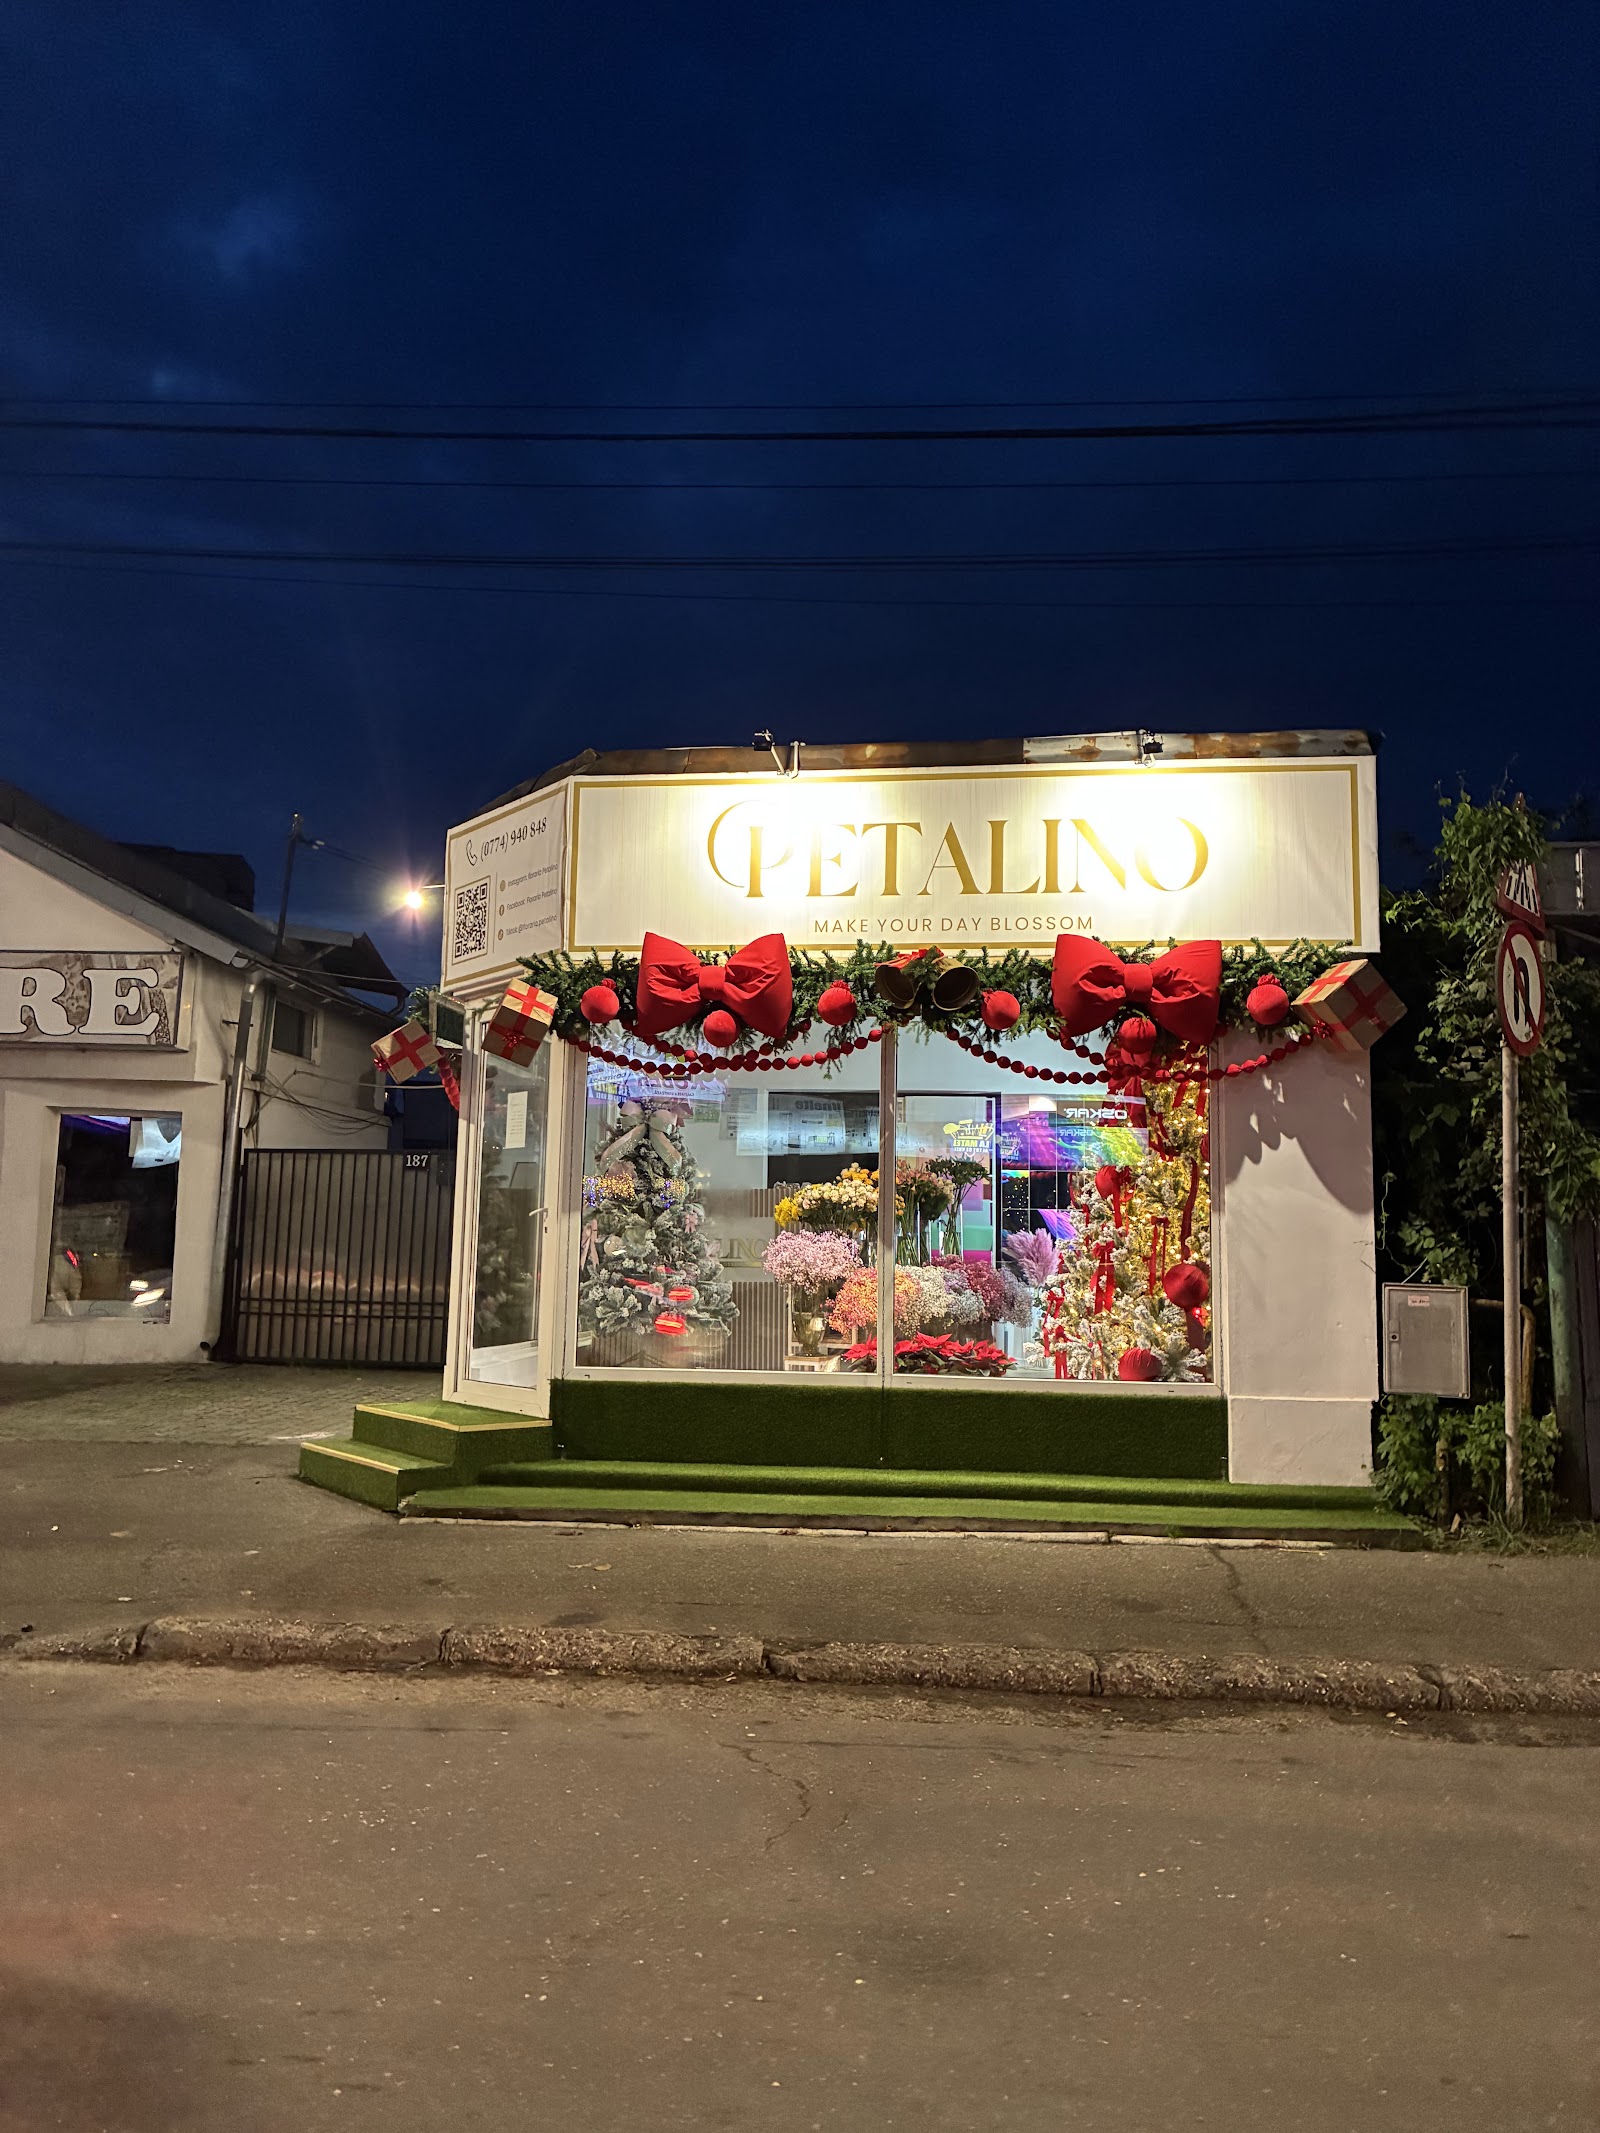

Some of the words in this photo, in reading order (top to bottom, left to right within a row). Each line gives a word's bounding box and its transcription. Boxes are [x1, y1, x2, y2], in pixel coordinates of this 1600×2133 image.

[480, 832, 508, 862] (0774)
[510, 825, 528, 847] 940
[529, 817, 547, 838] 848
[708, 802, 1209, 898] PETALINO
[814, 918, 869, 933] MAKE
[877, 917, 933, 933] YOUR
[941, 916, 982, 932] DAY
[990, 916, 1093, 931] BLOSSOM
[0, 966, 160, 1036] RE
[405, 1154, 429, 1168] 187
